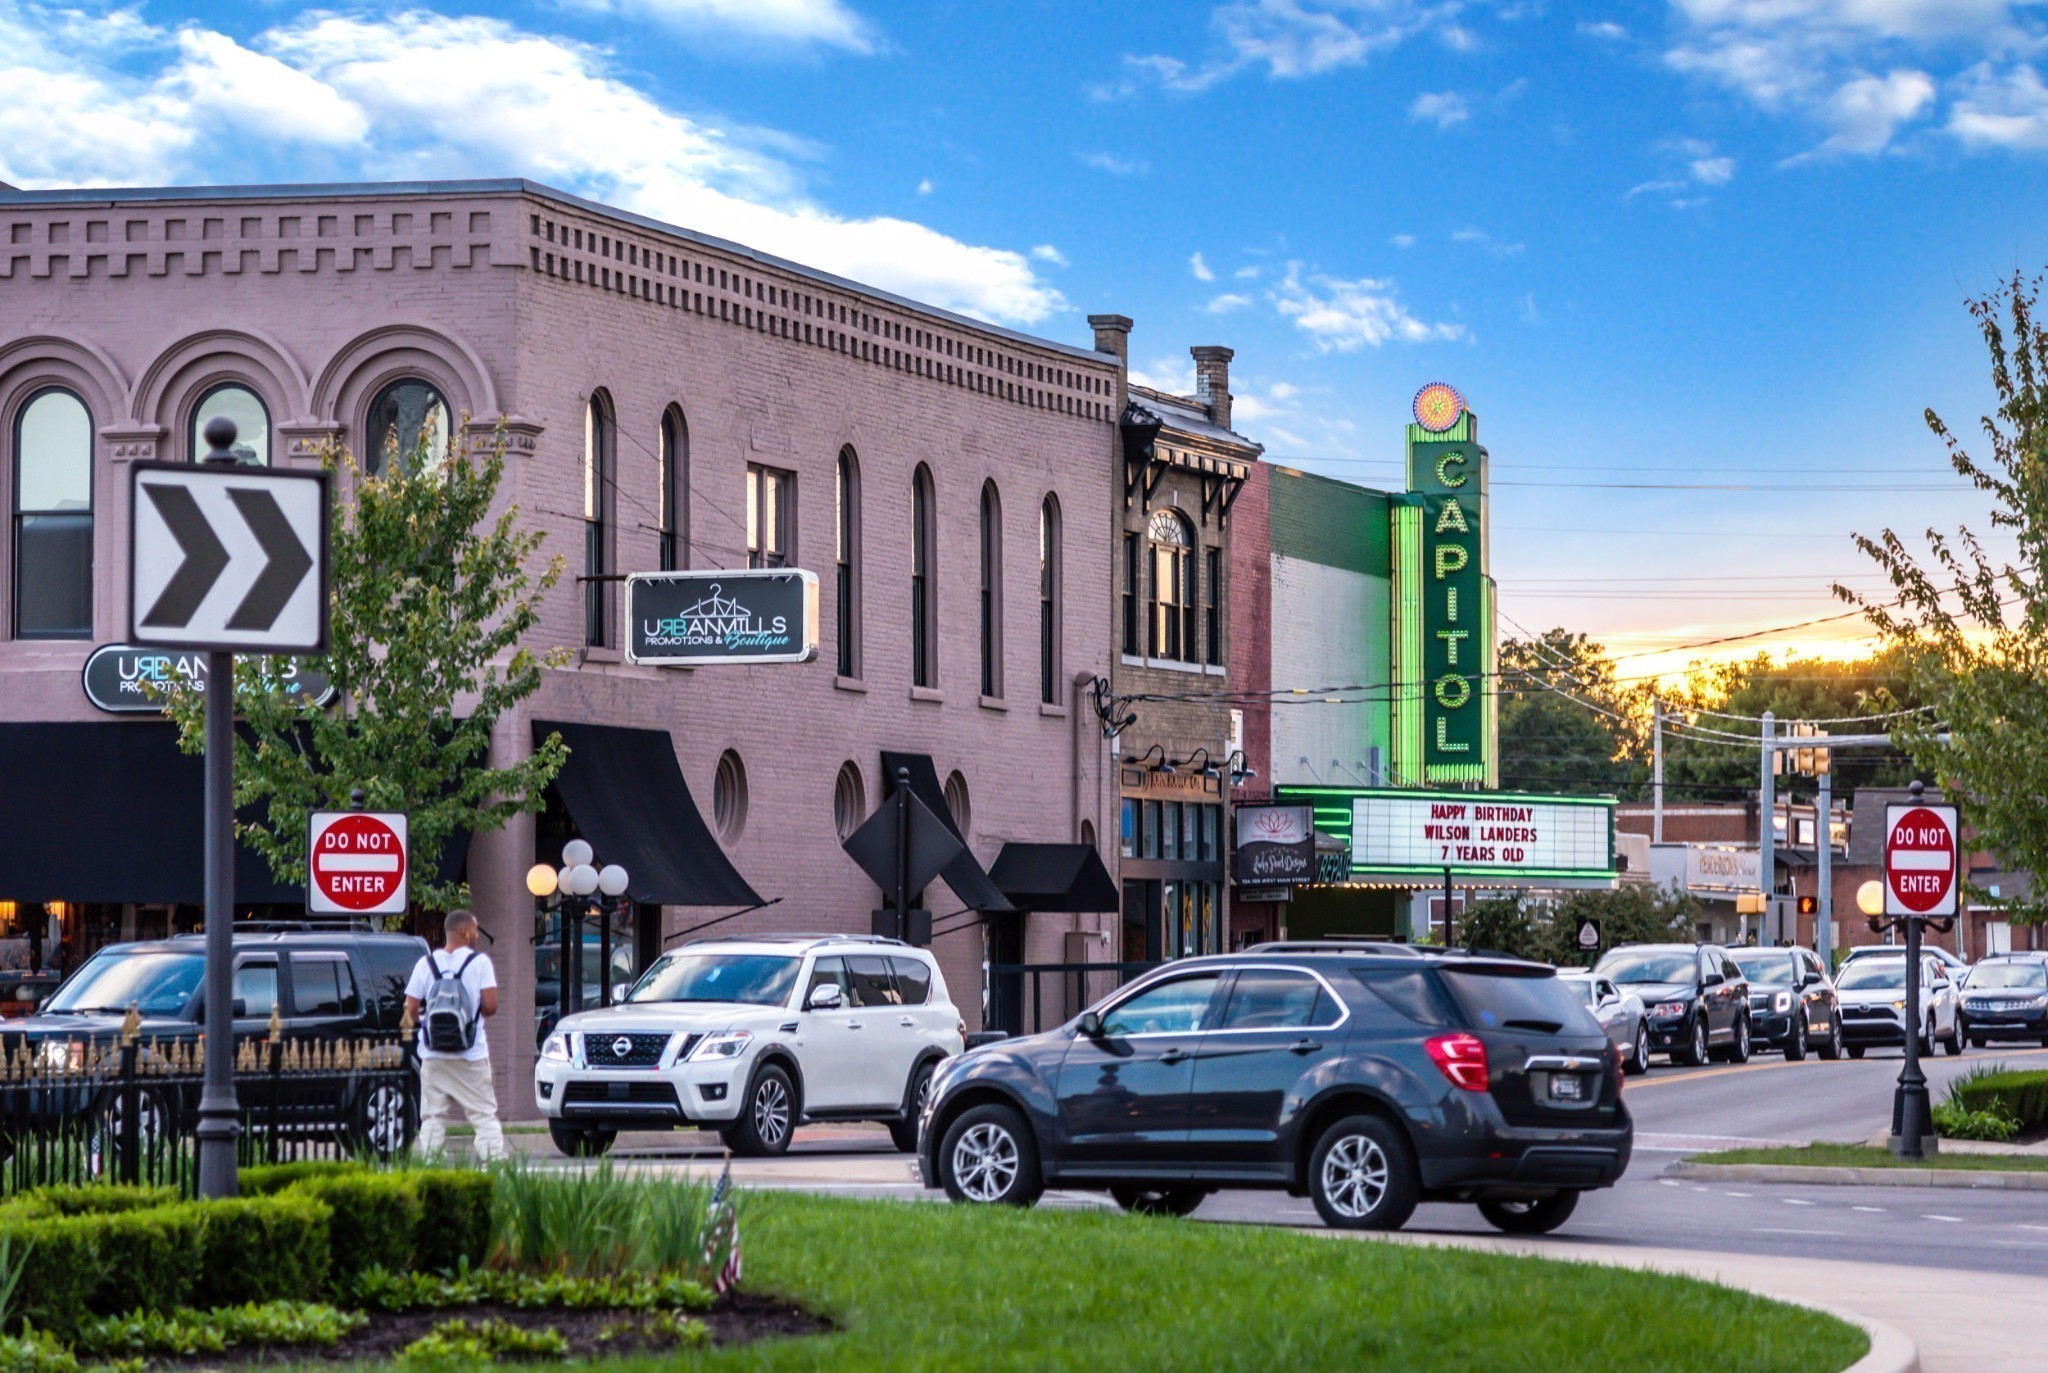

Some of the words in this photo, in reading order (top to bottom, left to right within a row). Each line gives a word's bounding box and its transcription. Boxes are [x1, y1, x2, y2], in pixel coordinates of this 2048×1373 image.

[1434, 451, 1470, 752] CAPITOL
[645, 635, 713, 646] PROMOTIONS
[715, 636, 723, 645] &
[724, 630, 791, 650] Boutique
[1431, 804, 1466, 820] HAPPY
[1475, 806, 1533, 823] BIRTHDAY
[325, 832, 349, 849] DO
[356, 833, 391, 850] NOT
[1424, 825, 1470, 840] WILSON
[1480, 826, 1537, 843] LANDERS
[1896, 827, 1915, 845] DO
[1919, 828, 1946, 846] NOT
[1441, 845, 1449, 861] 7
[1456, 845, 1496, 861] YEARS
[1502, 847, 1525, 862] OLD
[331, 876, 385, 893] ENTER
[1900, 875, 1941, 893] ENTER
